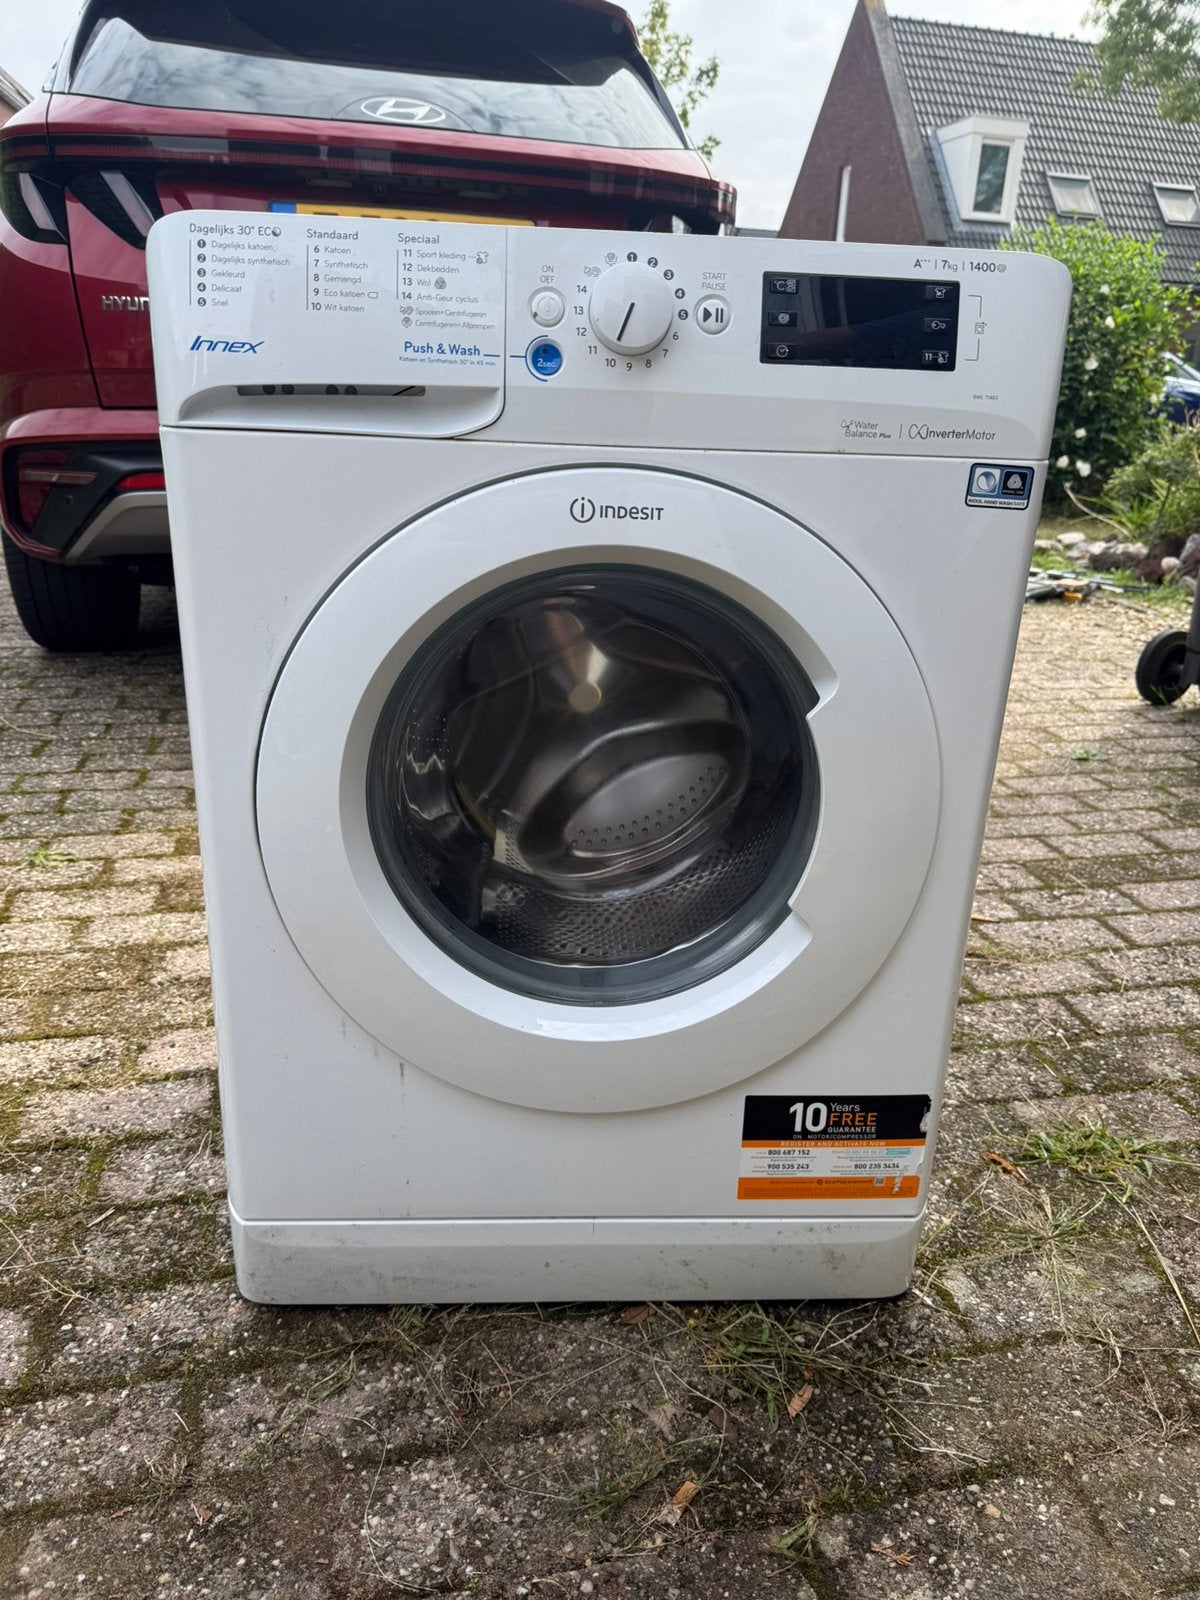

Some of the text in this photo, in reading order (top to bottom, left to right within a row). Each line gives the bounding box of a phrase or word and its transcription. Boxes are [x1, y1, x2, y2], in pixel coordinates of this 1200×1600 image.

[190, 223, 235, 236] Dagelijks
[306, 228, 359, 240] Standaard
[398, 232, 440, 245] Speciaal
[211, 240, 246, 251] Dagelijks
[313, 245, 352, 255] 6 Katoen
[211, 255, 246, 265] Dagelijks
[247, 257, 291, 266] synthetisch
[403, 249, 467, 262] 11 Sport kleding
[313, 259, 369, 270] 7 Synthetisch
[402, 263, 460, 274] 12 Dekbedden
[541, 264, 554, 273] ON
[941, 260, 958, 272] 7kg
[969, 261, 996, 272] 1400
[211, 269, 246, 279] Gekleurd
[313, 273, 362, 285] 8 Gemengd
[702, 272, 726, 281] START
[402, 277, 432, 287] 13 Wol
[702, 282, 727, 291] PAUSE
[211, 284, 243, 293] Delicaat
[313, 287, 366, 298] 9 Eco katoen
[576, 285, 587, 294] 14
[211, 298, 229, 307] Snel
[401, 292, 479, 304] 14 Anti-Geur cyclus
[311, 302, 365, 312] 10 Wit katoen
[573, 306, 584, 315] 13
[576, 327, 587, 336] 12
[672, 331, 679, 340] 6
[190, 335, 265, 354] Innex
[404, 341, 481, 356] Push & Wash
[588, 345, 598, 354] 11
[662, 349, 669, 358] 7
[925, 353, 932, 361] 11
[428, 357, 458, 365] Synthetisch
[605, 358, 616, 368] 10
[645, 359, 652, 369] 8
[626, 362, 633, 372] 9
[854, 420, 879, 430] Water
[845, 429, 878, 439] Balance
[789, 1102, 861, 1133] 10 Years
[829, 1112, 878, 1126] FREE
[827, 1126, 877, 1134] GUARANTEE
[780, 1140, 814, 1148] REGISTER
[817, 1140, 834, 1148] AND
[869, 1139, 886, 1147] NOW
